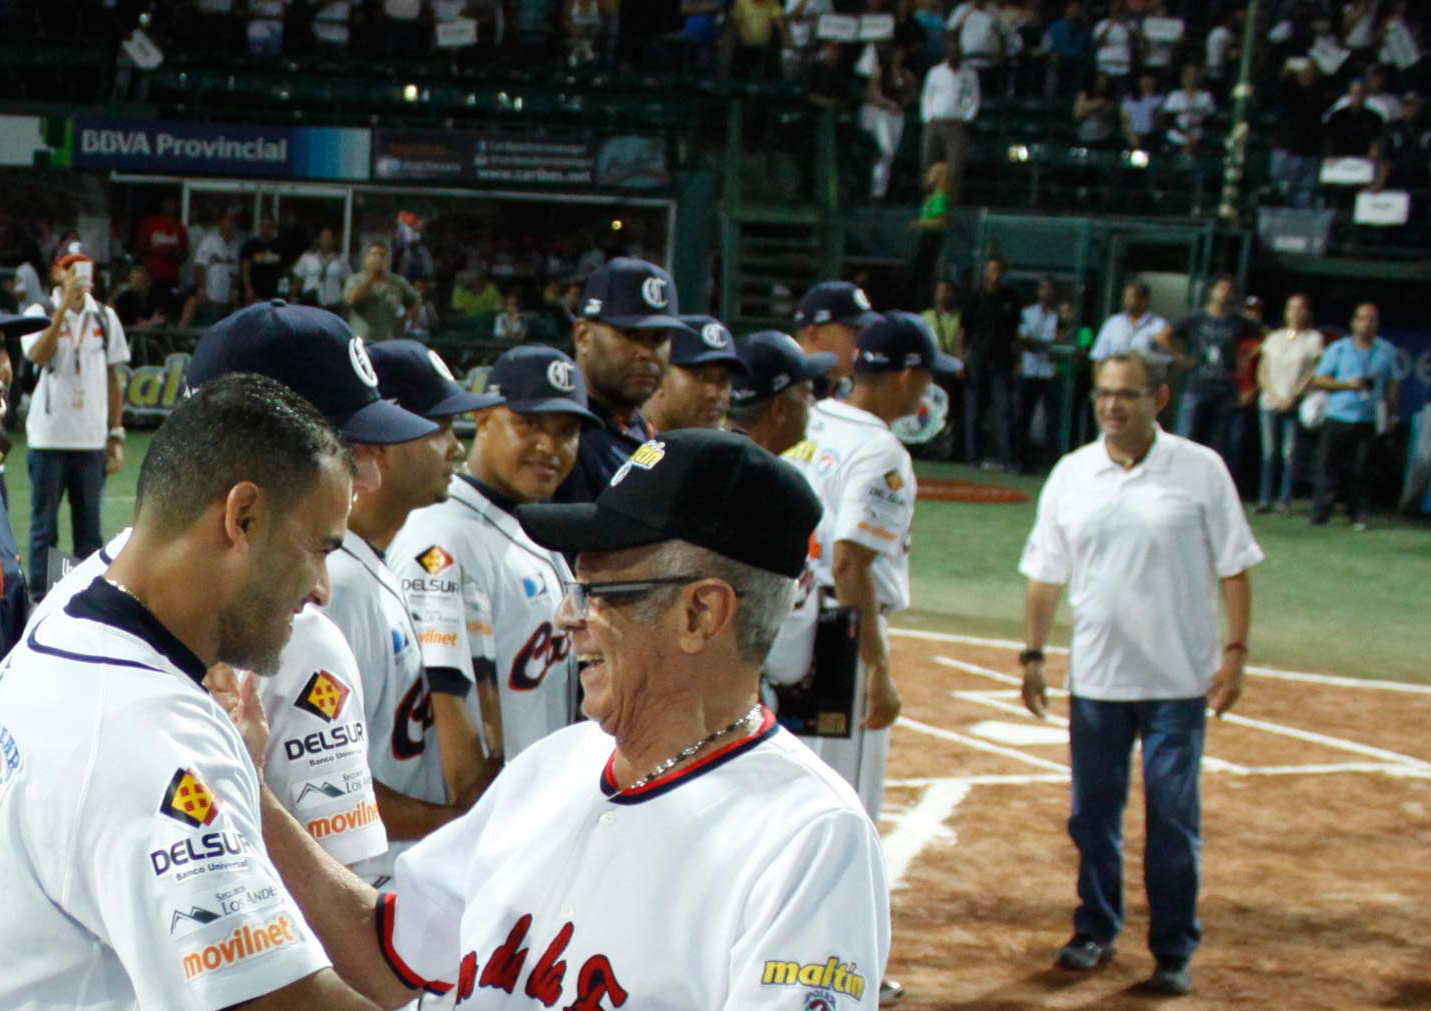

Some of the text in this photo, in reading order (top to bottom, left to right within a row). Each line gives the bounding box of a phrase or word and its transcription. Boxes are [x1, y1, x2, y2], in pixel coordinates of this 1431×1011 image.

[81, 128, 287, 163] BBVA Provincial
[401, 578, 460, 594] DELSUR
[284, 722, 365, 762] DELSUR
[182, 915, 294, 980] movilnet
[760, 955, 866, 1002] maltín
